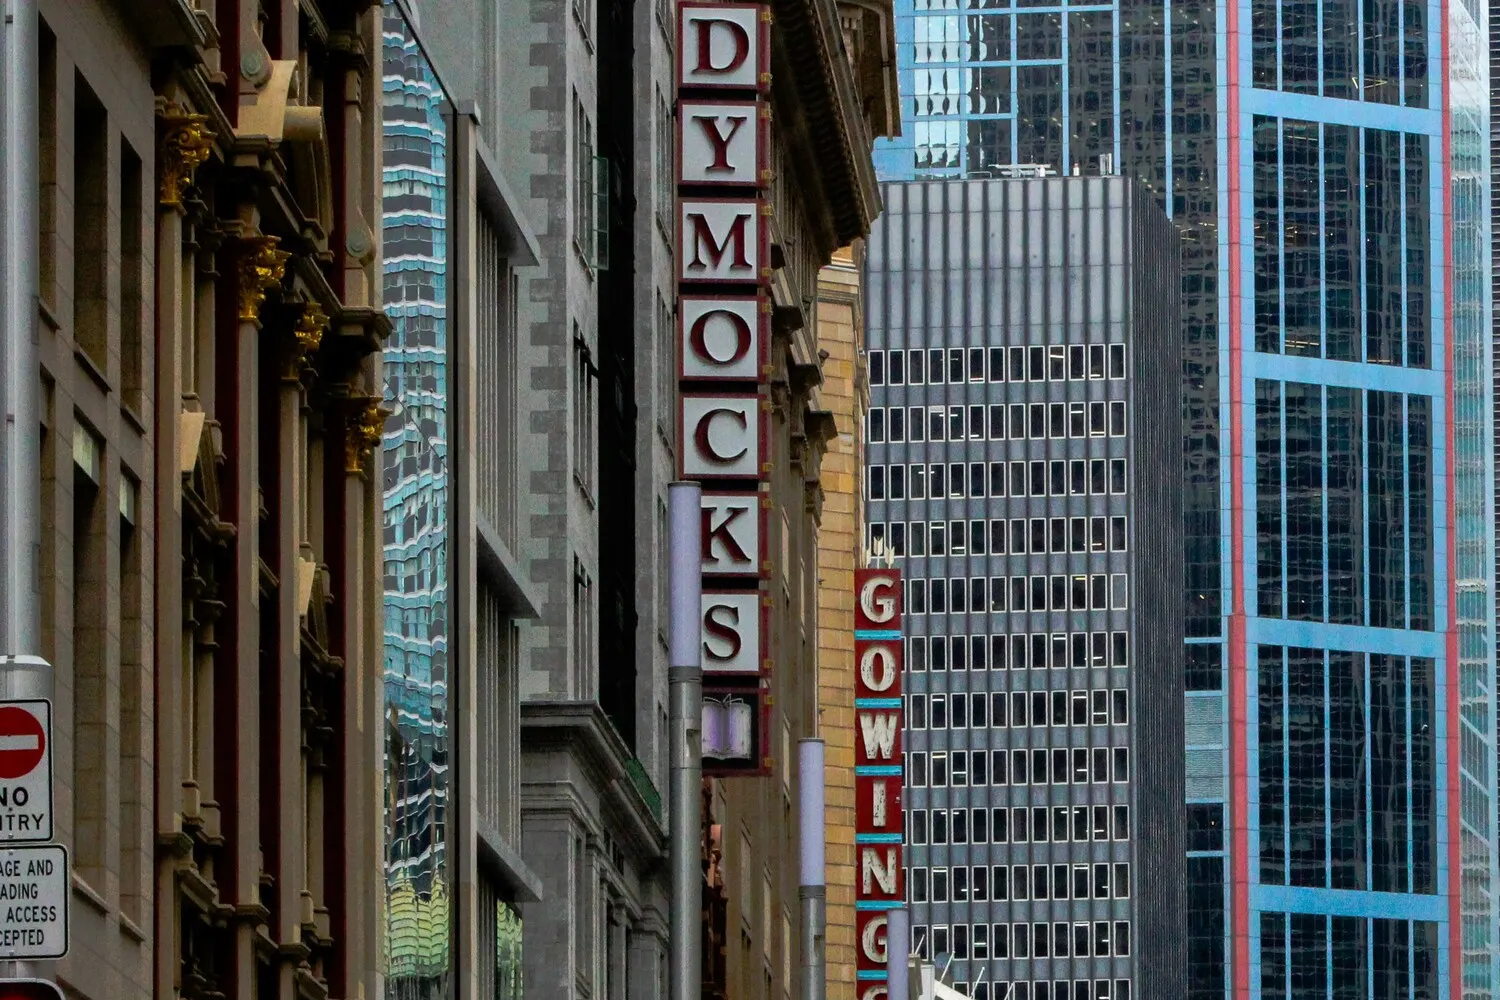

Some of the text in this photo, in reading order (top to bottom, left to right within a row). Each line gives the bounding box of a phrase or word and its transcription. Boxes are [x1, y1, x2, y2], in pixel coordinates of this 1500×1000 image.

[687, 18, 752, 661] DYMOCKS
[0, 813, 44, 831] TRY
[27, 858, 54, 876] AND
[6, 904, 57, 923] ACCESS
